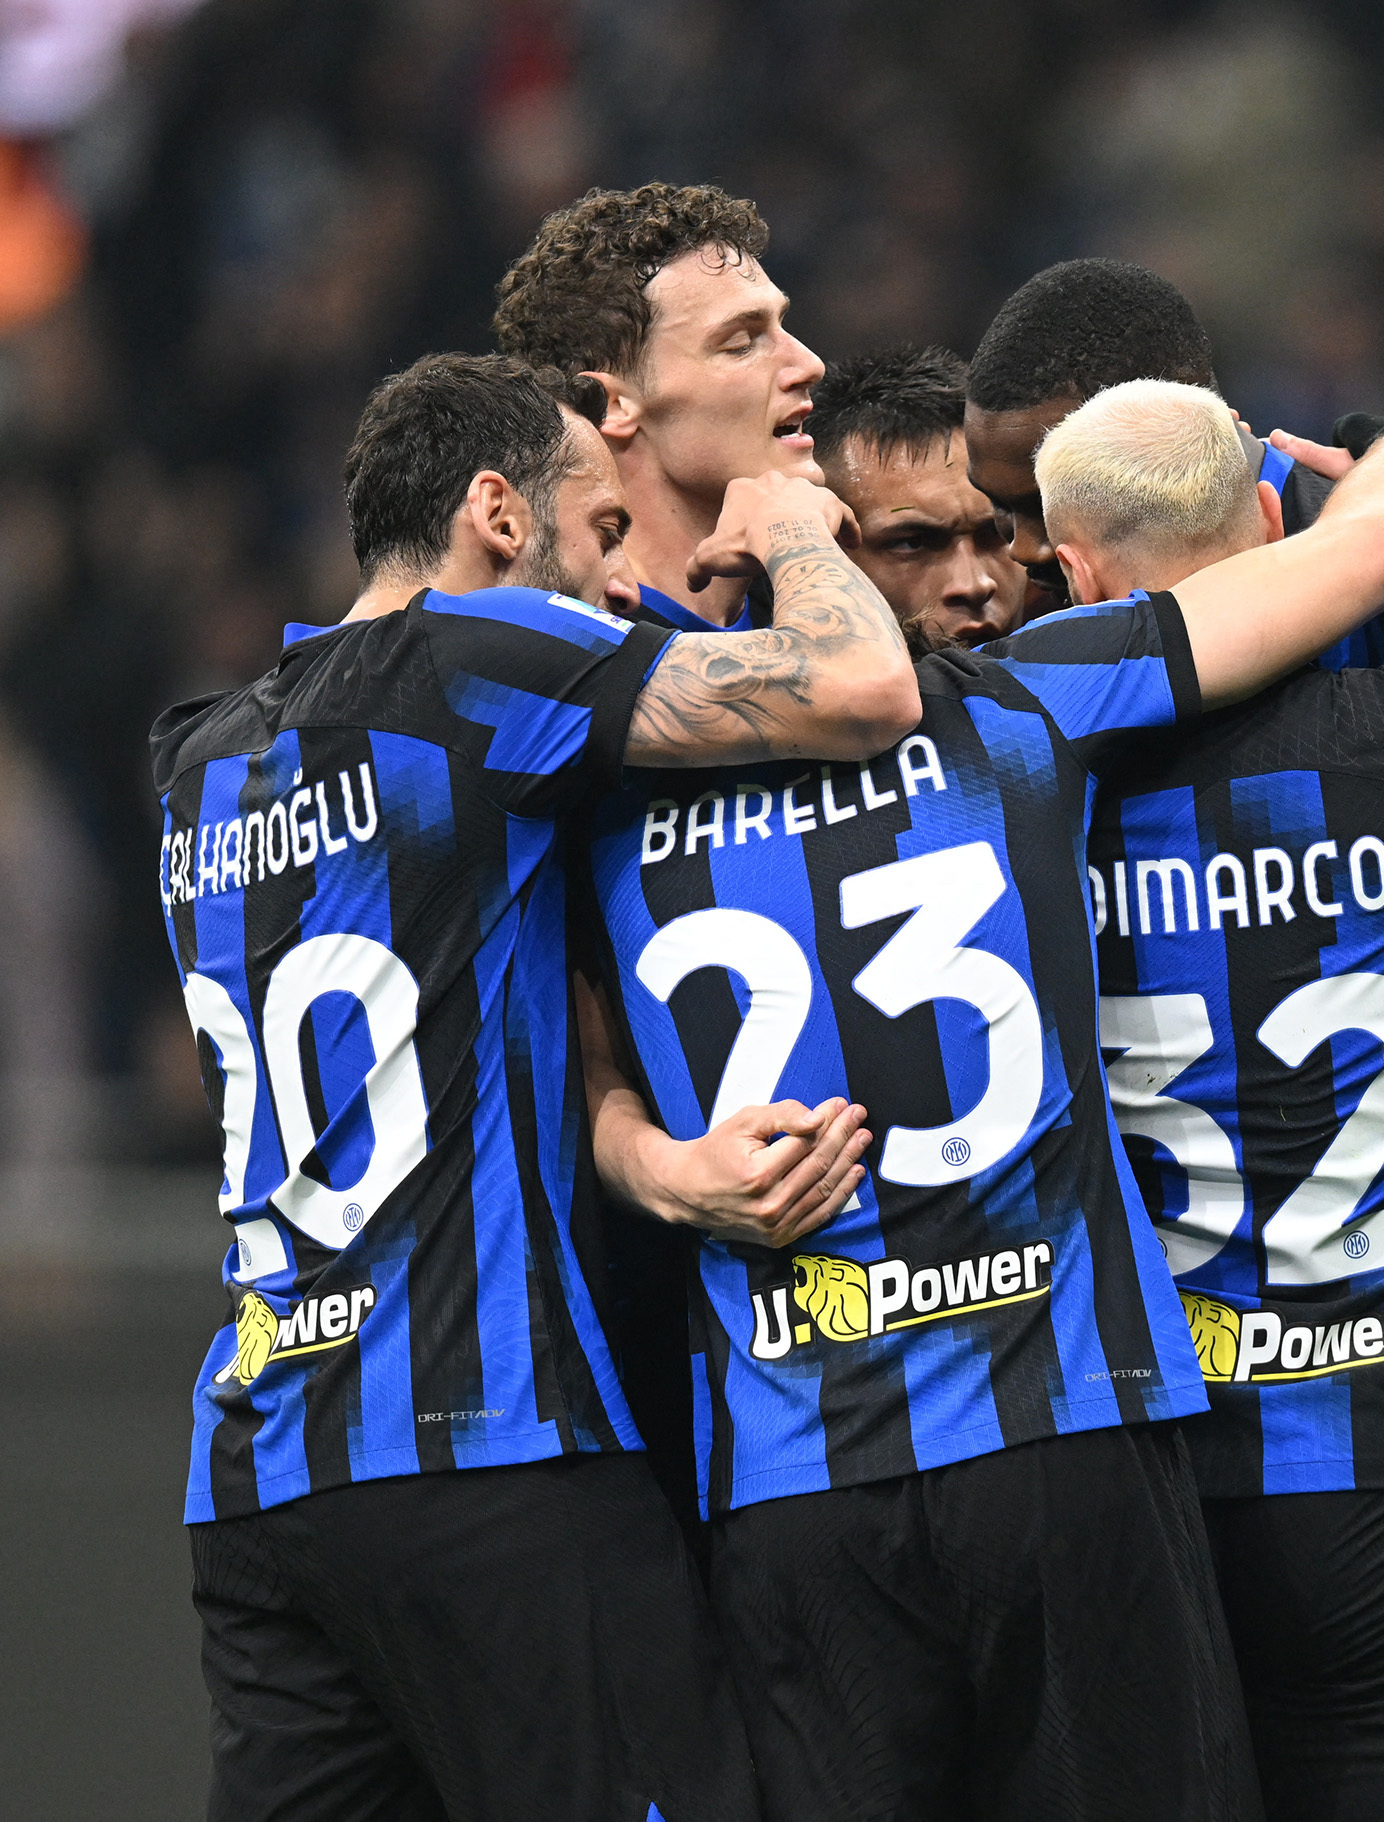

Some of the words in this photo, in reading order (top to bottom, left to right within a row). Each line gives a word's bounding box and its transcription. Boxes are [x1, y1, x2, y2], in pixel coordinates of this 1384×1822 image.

[641, 735, 947, 865] BARELLA
[635, 841, 1044, 1238] 23
[868, 1242, 1051, 1334] Power
